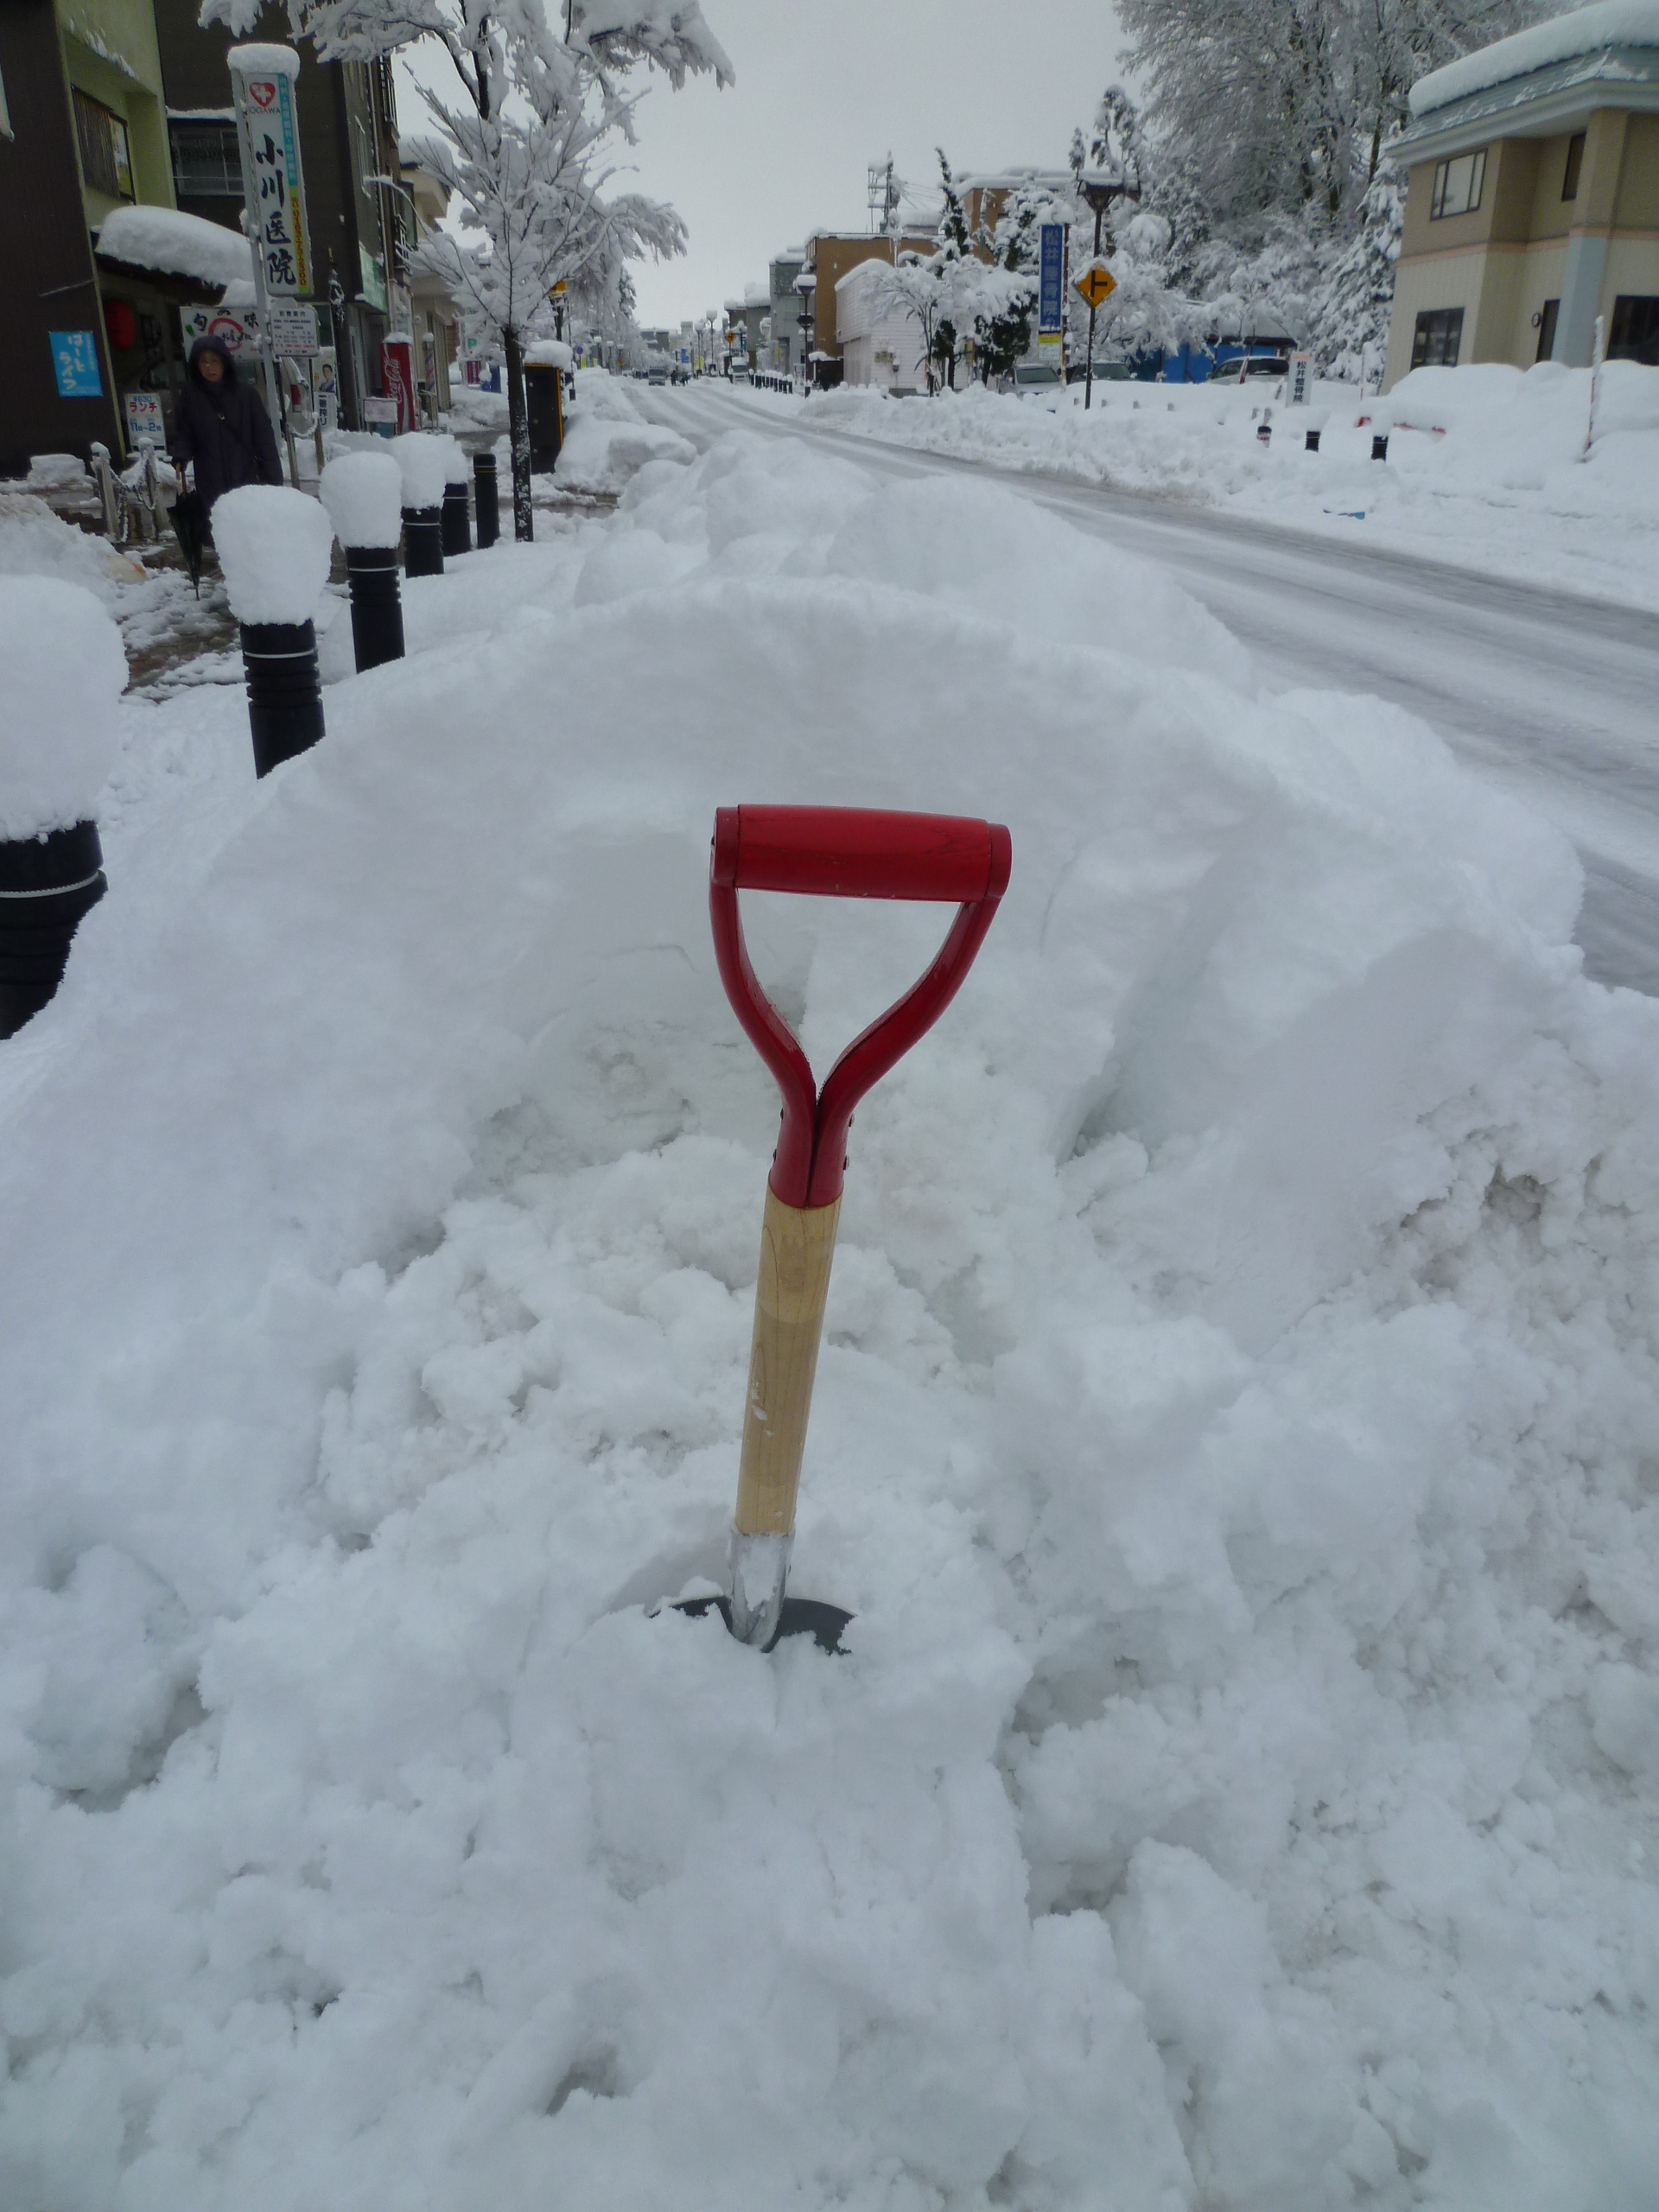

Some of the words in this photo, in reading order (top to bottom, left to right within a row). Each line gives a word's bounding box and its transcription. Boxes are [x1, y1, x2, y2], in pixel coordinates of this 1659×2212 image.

[255, 133, 296, 286] 小川医院
[130, 401, 158, 413] ランチ
